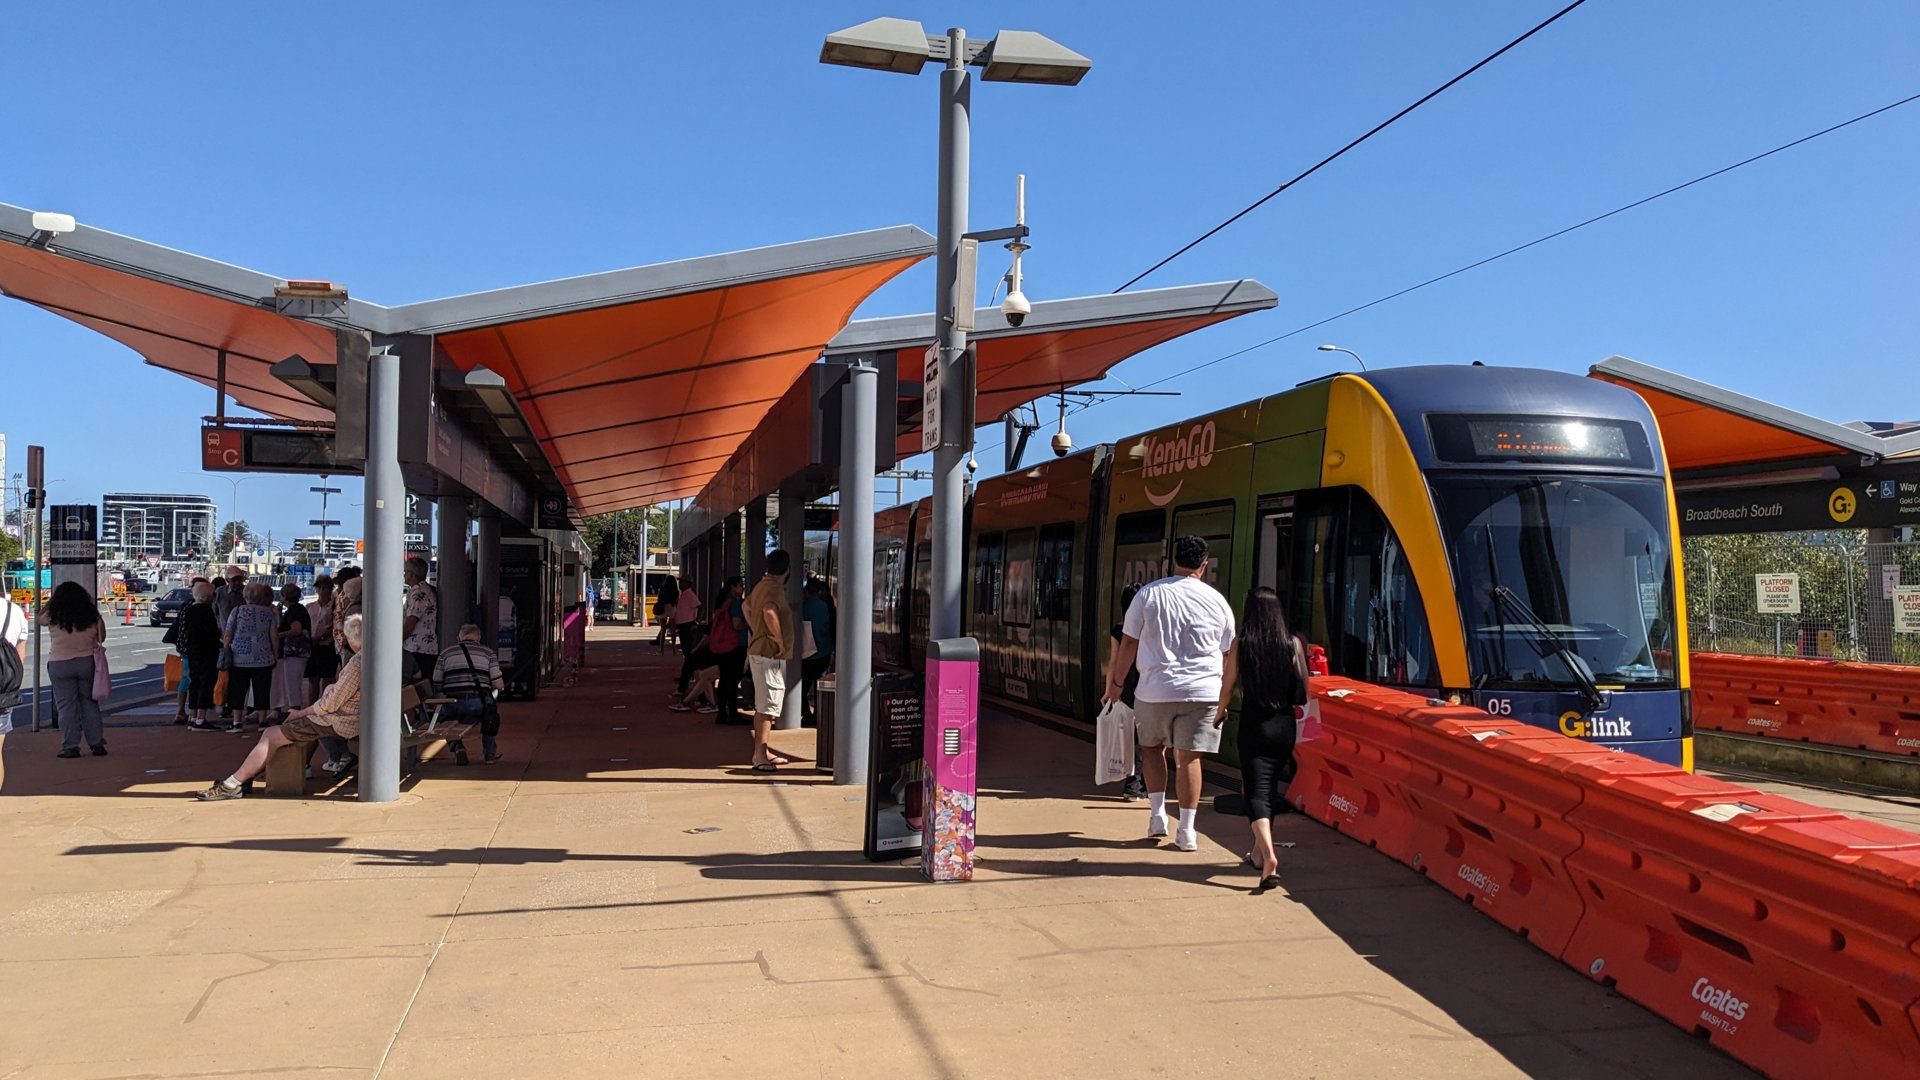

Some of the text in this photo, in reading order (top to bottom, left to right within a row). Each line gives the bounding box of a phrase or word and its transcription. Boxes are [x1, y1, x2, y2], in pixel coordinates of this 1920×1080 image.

[926, 385, 938, 406] WATCH
[927, 408, 935, 425] FOR
[924, 427, 938, 447] TRAMS
[222, 448, 239, 466] C
[1141, 420, 1216, 479] KenoGO
[1899, 482, 1917, 494] Way
[1899, 497, 1913, 505] Gold
[1685, 503, 1783, 522] Broadbeach South
[1487, 698, 1512, 715] 05
[1558, 710, 1632, 738] G:link
[1691, 977, 1750, 1021] Coates
[1700, 1010, 1738, 1036] MASH TL-2
